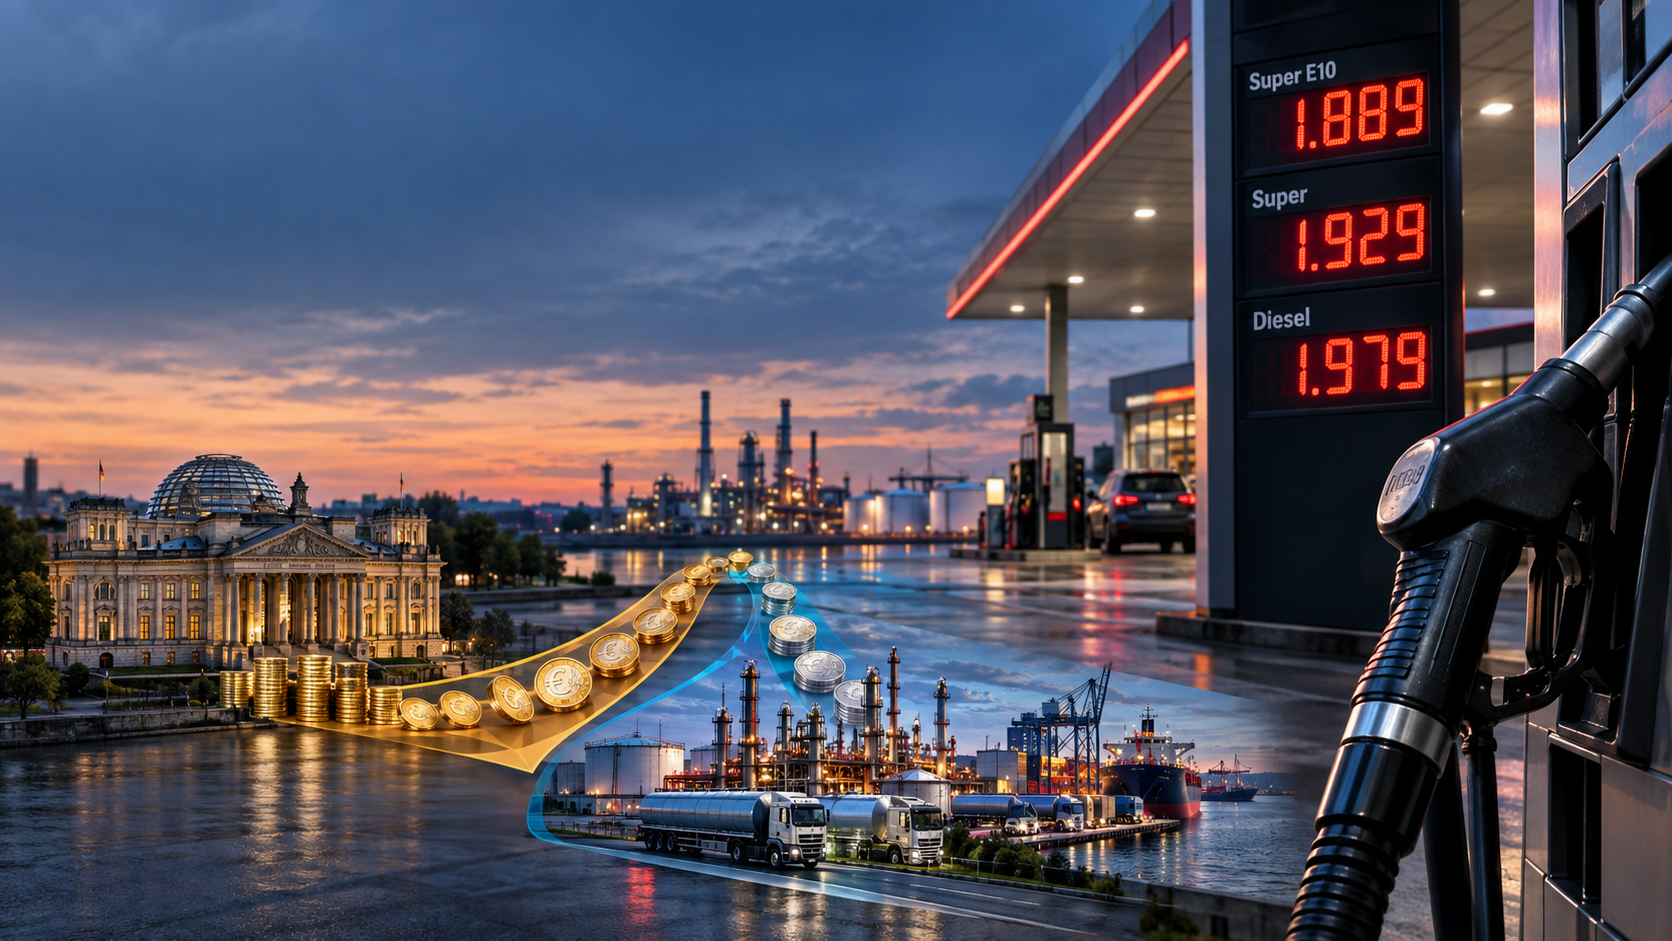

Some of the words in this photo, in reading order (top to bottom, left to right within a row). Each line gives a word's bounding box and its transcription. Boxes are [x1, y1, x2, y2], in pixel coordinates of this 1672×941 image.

[1249, 70, 1302, 92] Super
[1306, 60, 1337, 82] E10
[1296, 77, 1424, 150] 1.889
[1252, 188, 1308, 211] Super
[1297, 202, 1426, 273] 1.929
[1253, 307, 1311, 331] Diesel
[1298, 331, 1426, 397] 1.979
